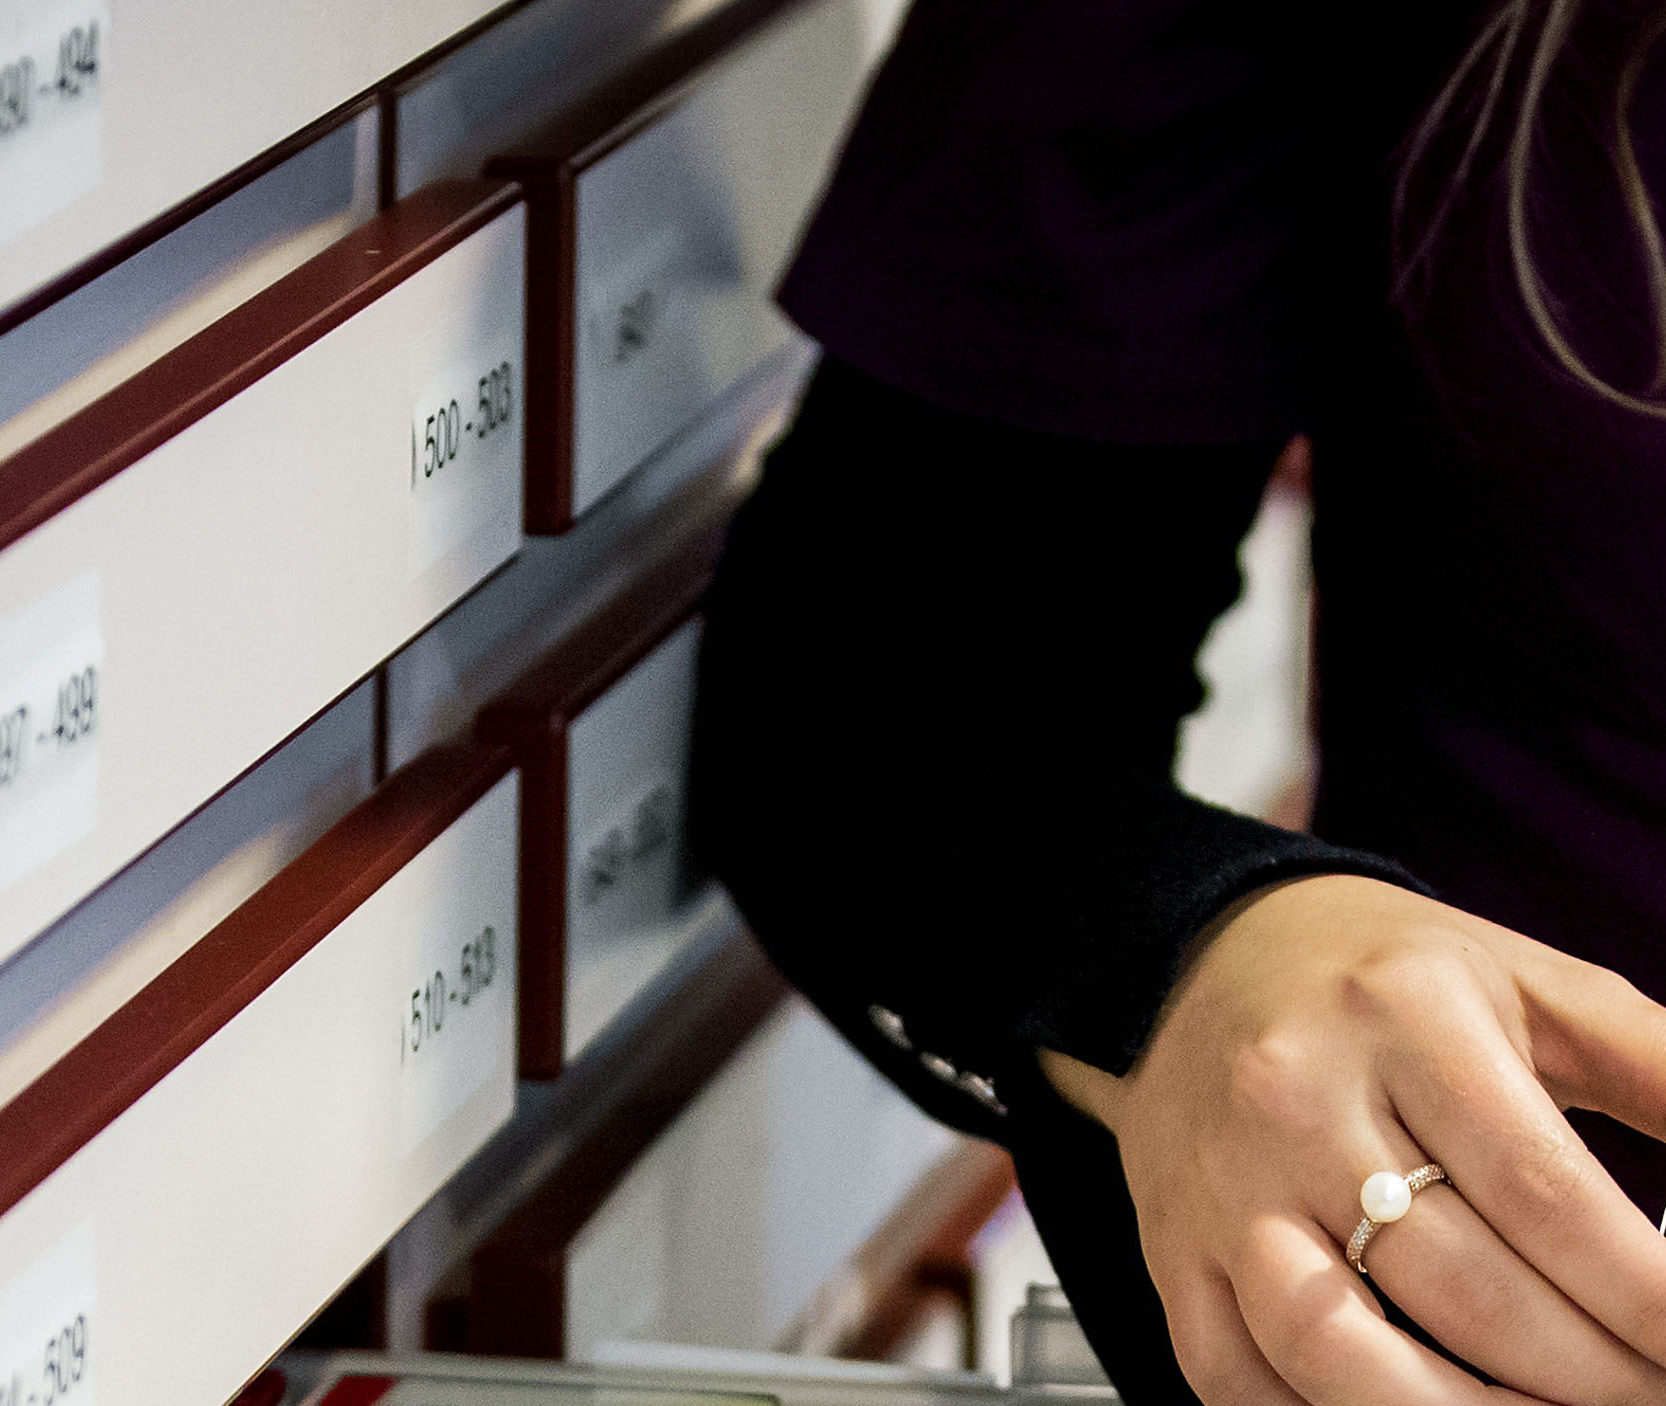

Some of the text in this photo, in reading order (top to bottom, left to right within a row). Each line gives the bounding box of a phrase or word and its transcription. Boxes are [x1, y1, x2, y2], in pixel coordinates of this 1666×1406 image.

[424, 398, 459, 478] 500
[478, 360, 511, 438] 503
[54, 667, 99, 744] 499
[411, 926, 495, 1052] 510 513
